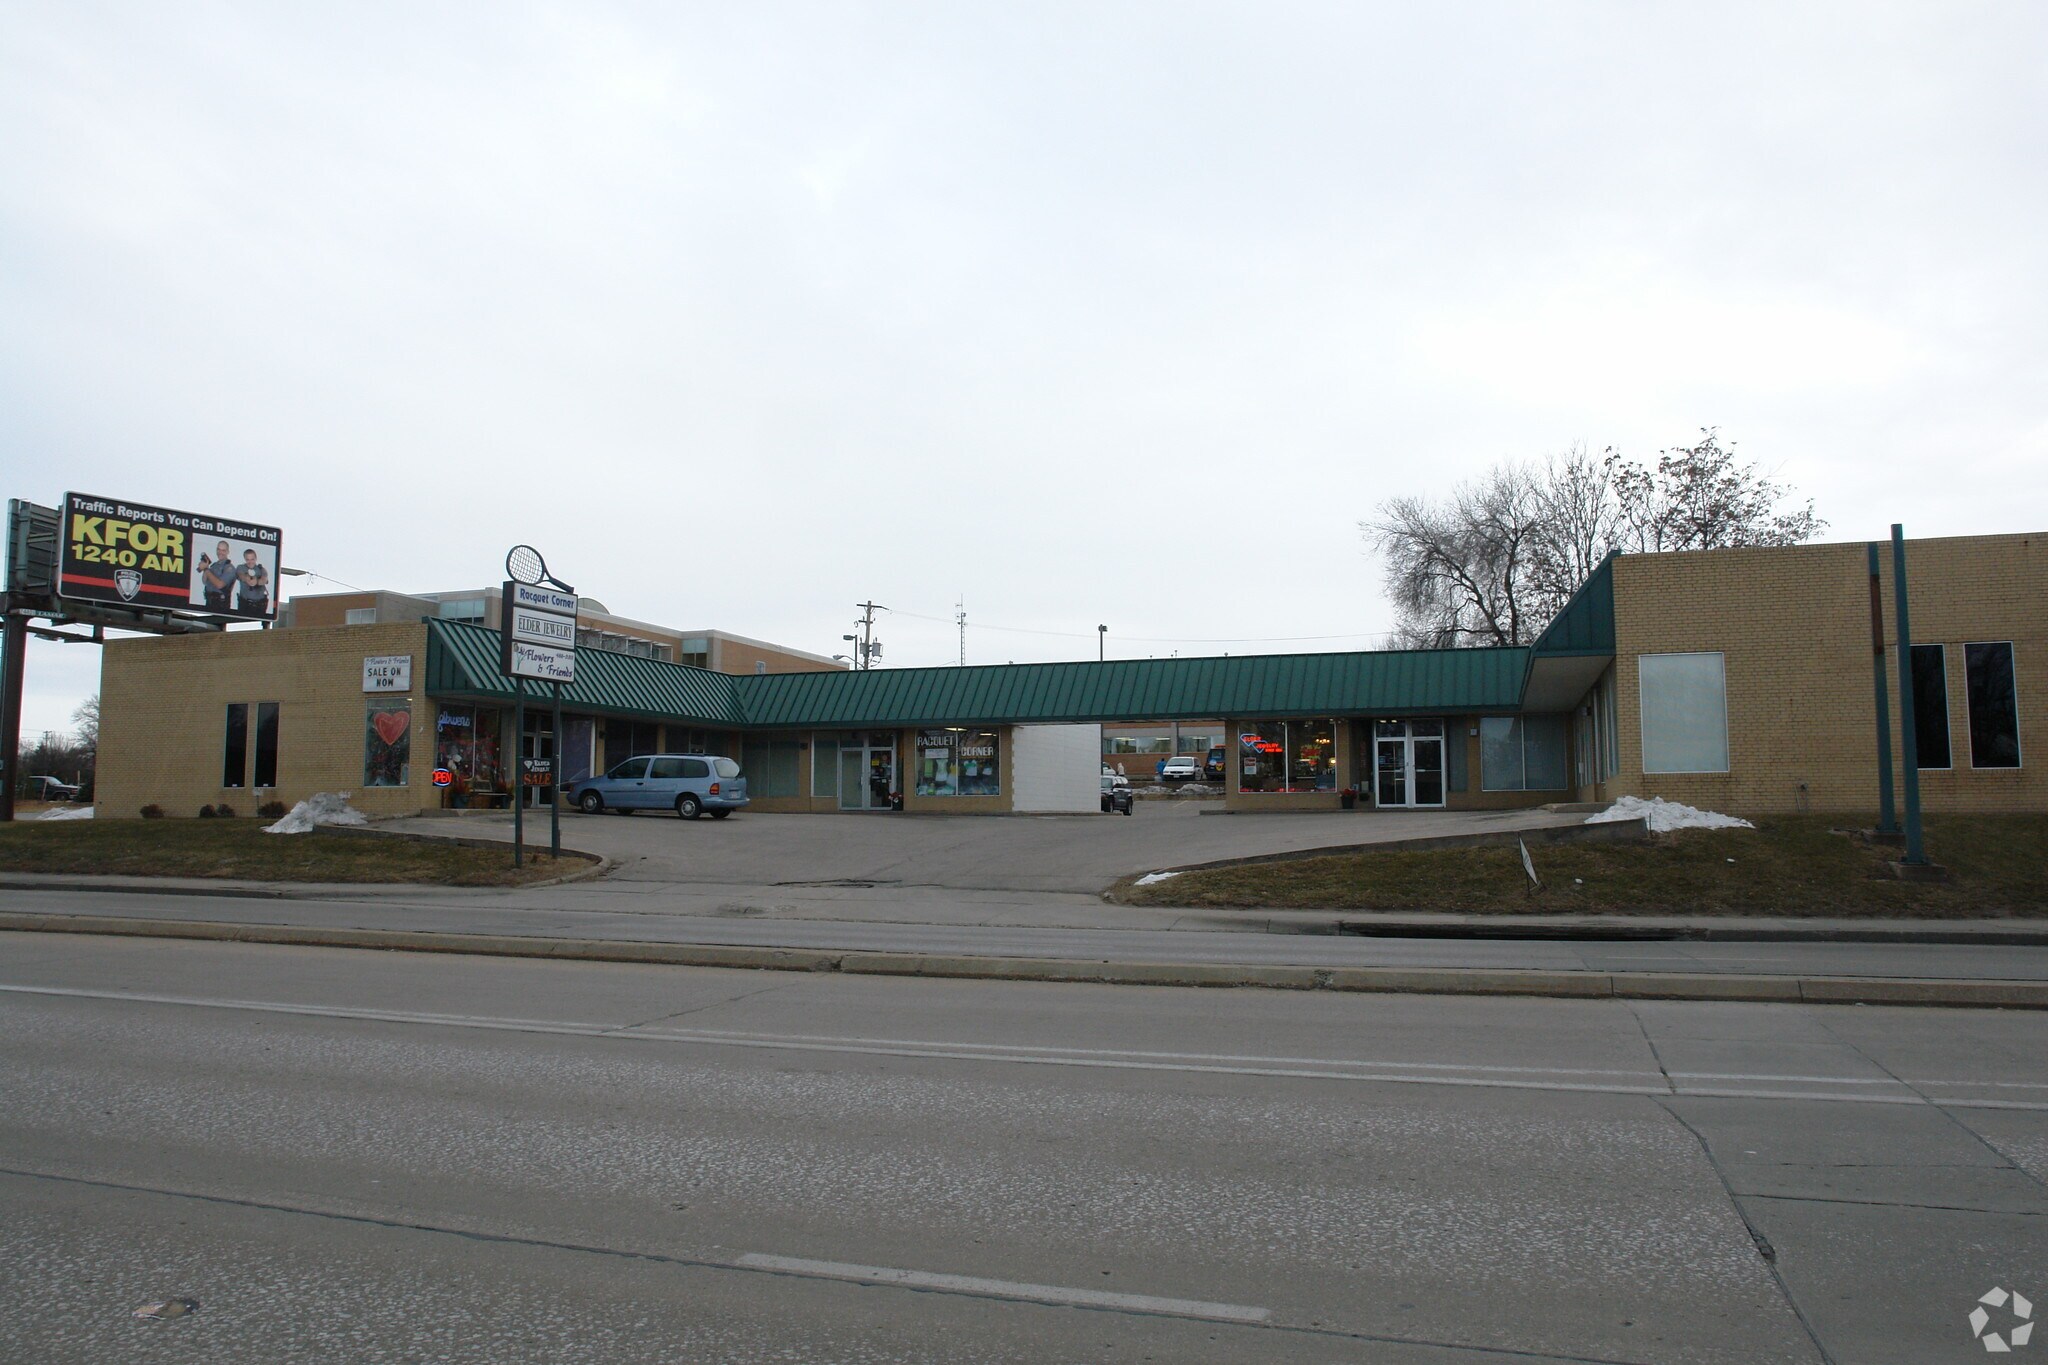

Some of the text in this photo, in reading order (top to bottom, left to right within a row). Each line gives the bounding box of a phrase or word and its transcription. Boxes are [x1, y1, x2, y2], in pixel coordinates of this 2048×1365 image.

[73, 498, 278, 542] Traffic Reports You Can Depend On!
[72, 513, 184, 557] KFOR
[72, 543, 184, 574] 1240 AM
[520, 587, 575, 609] Racquet Corner
[518, 617, 573, 639] ELDER JEWELRY
[525, 649, 554, 663] Flowers
[367, 667, 402, 677] SALE ON
[546, 664, 573, 678] Friends
[376, 678, 394, 687] NOW
[917, 736, 954, 746] RACQUET
[961, 747, 994, 756] CORNER
[431, 771, 454, 783] OPEN
[523, 773, 552, 785] SALE
